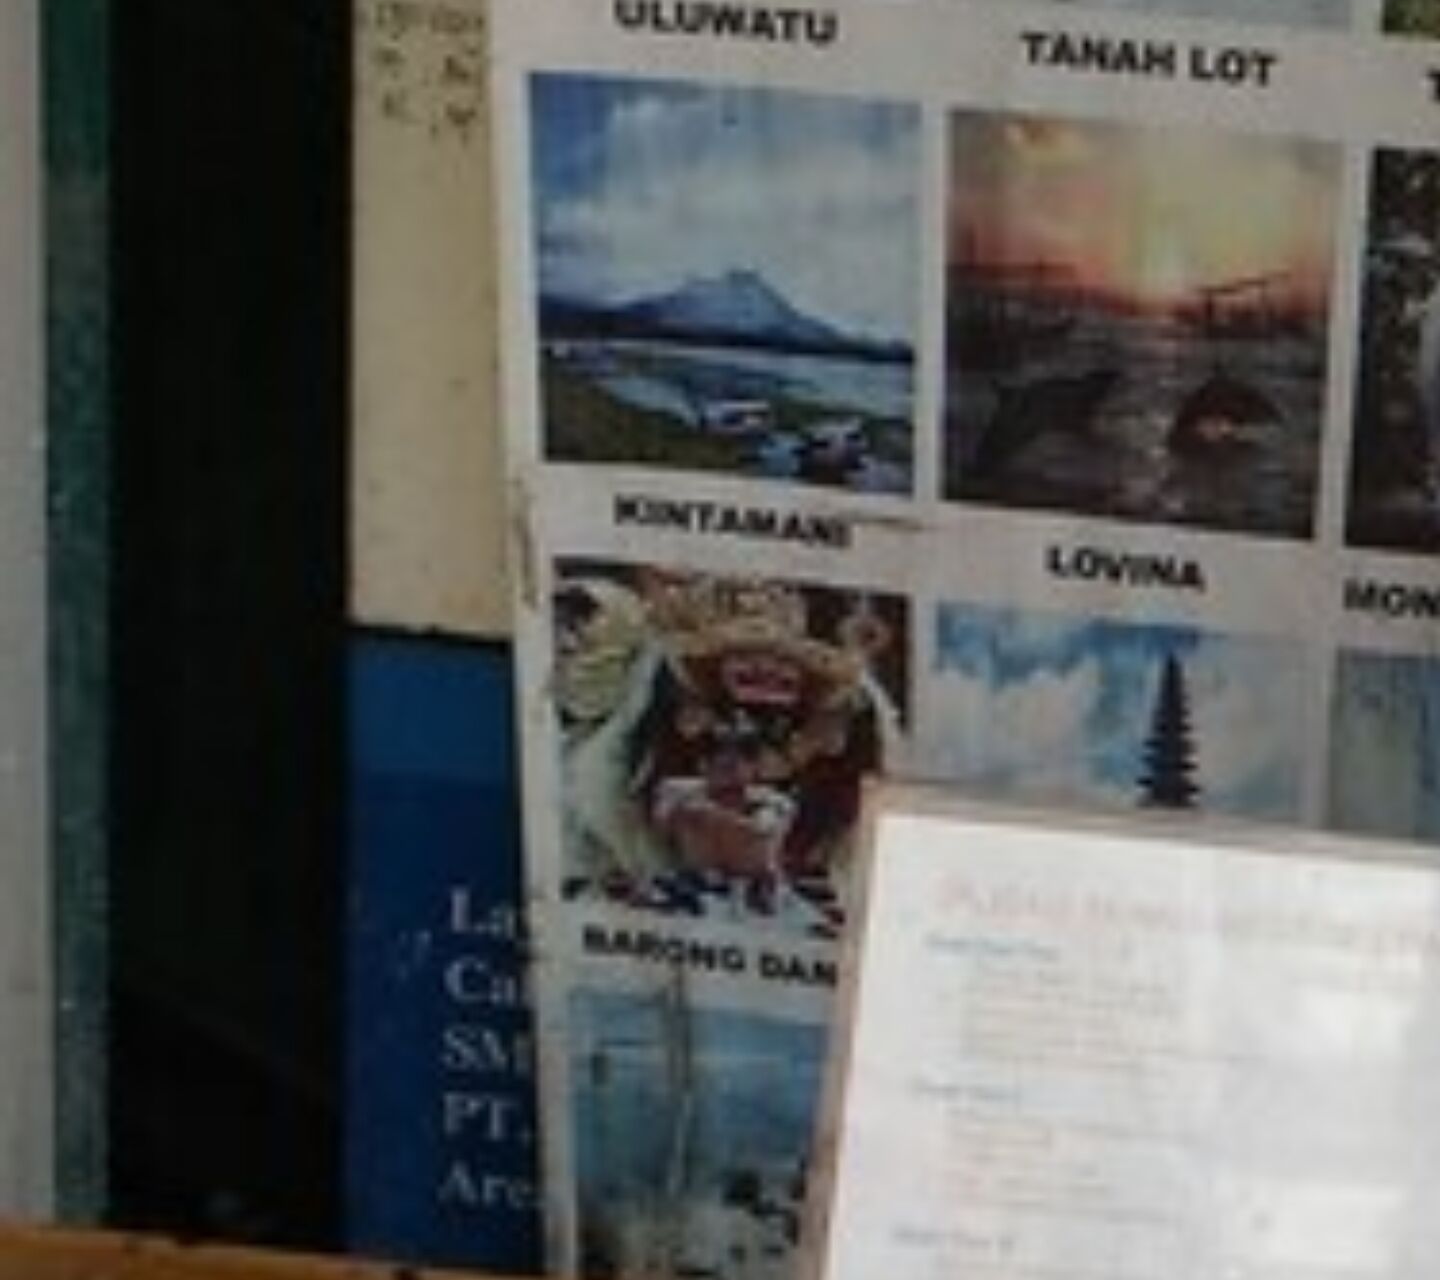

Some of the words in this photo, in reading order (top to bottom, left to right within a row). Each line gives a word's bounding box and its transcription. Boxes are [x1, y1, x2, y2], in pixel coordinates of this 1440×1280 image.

[1020, 32, 1176, 78] TANAH
[1189, 47, 1277, 86] LOT
[614, 493, 850, 548] KINTAMANI
[1046, 545, 1206, 591] LOVINA
[583, 924, 744, 973] BARONG
